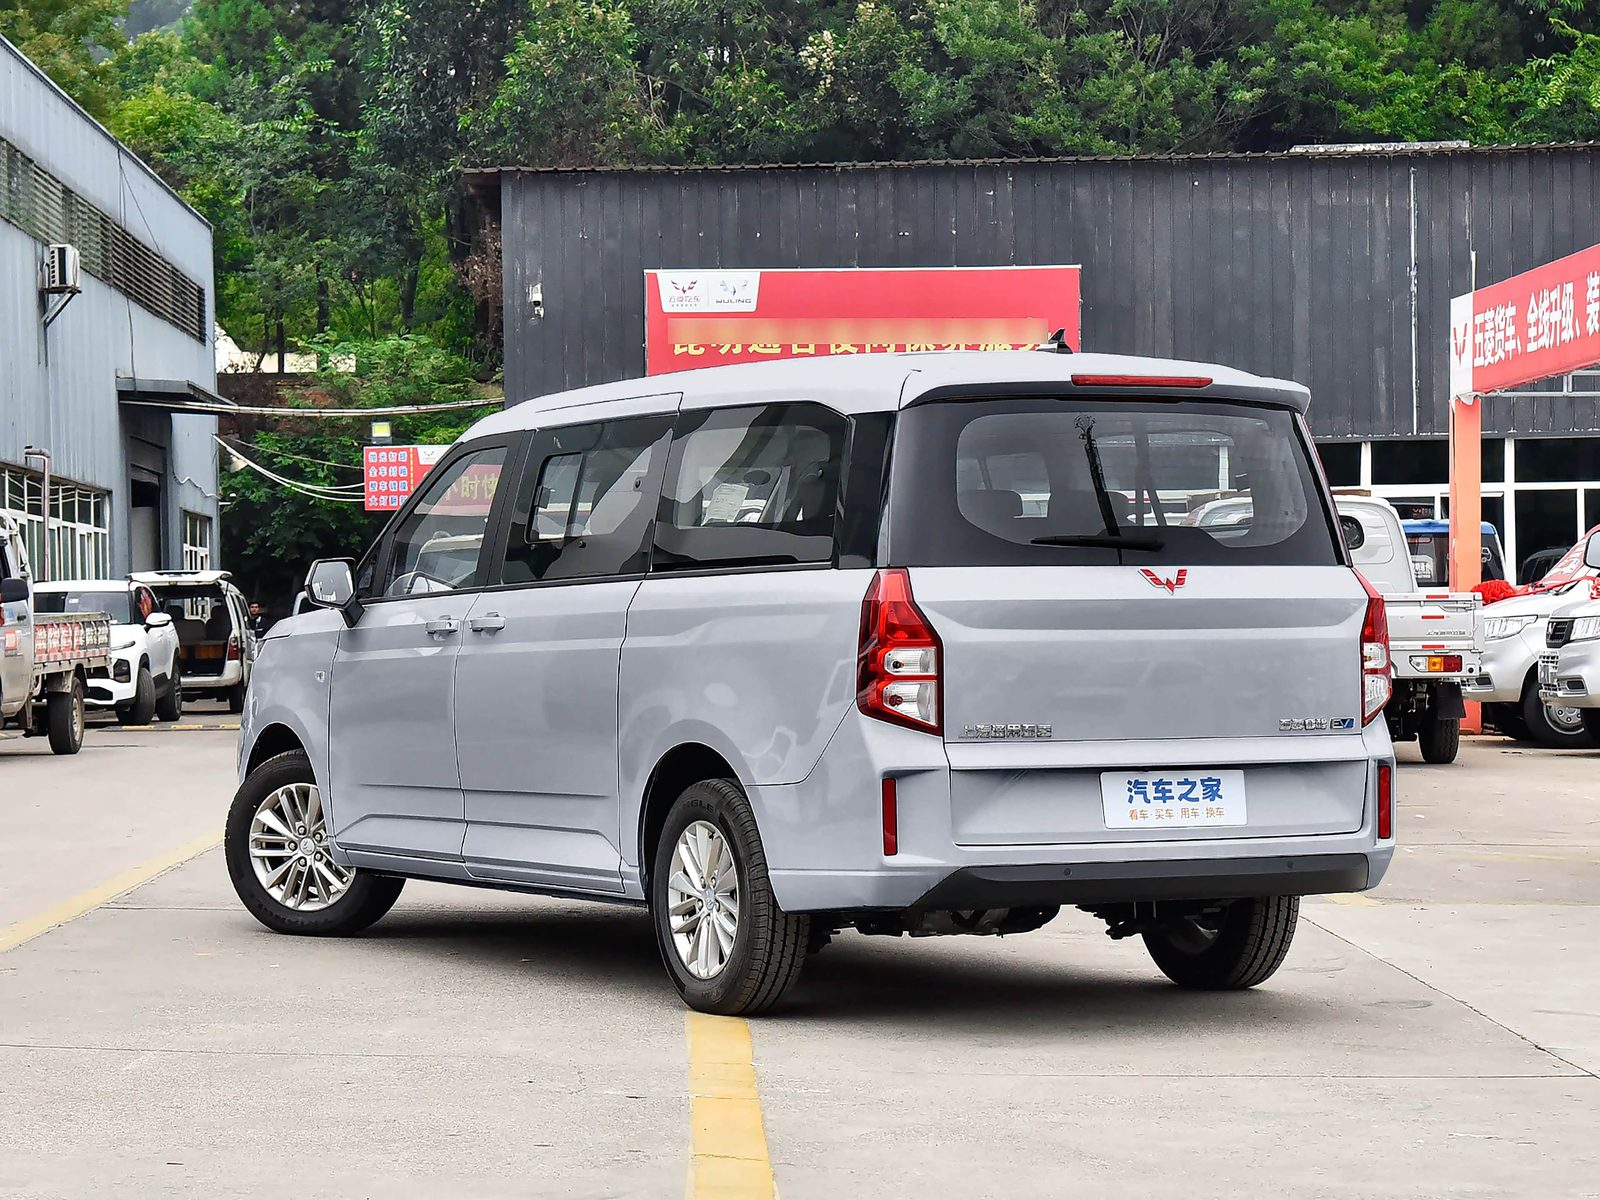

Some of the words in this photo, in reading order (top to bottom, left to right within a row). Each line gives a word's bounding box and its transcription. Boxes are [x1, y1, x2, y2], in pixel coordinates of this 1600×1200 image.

[1332, 718, 1354, 729] EV
[1127, 777, 1223, 804] 汽车之家
